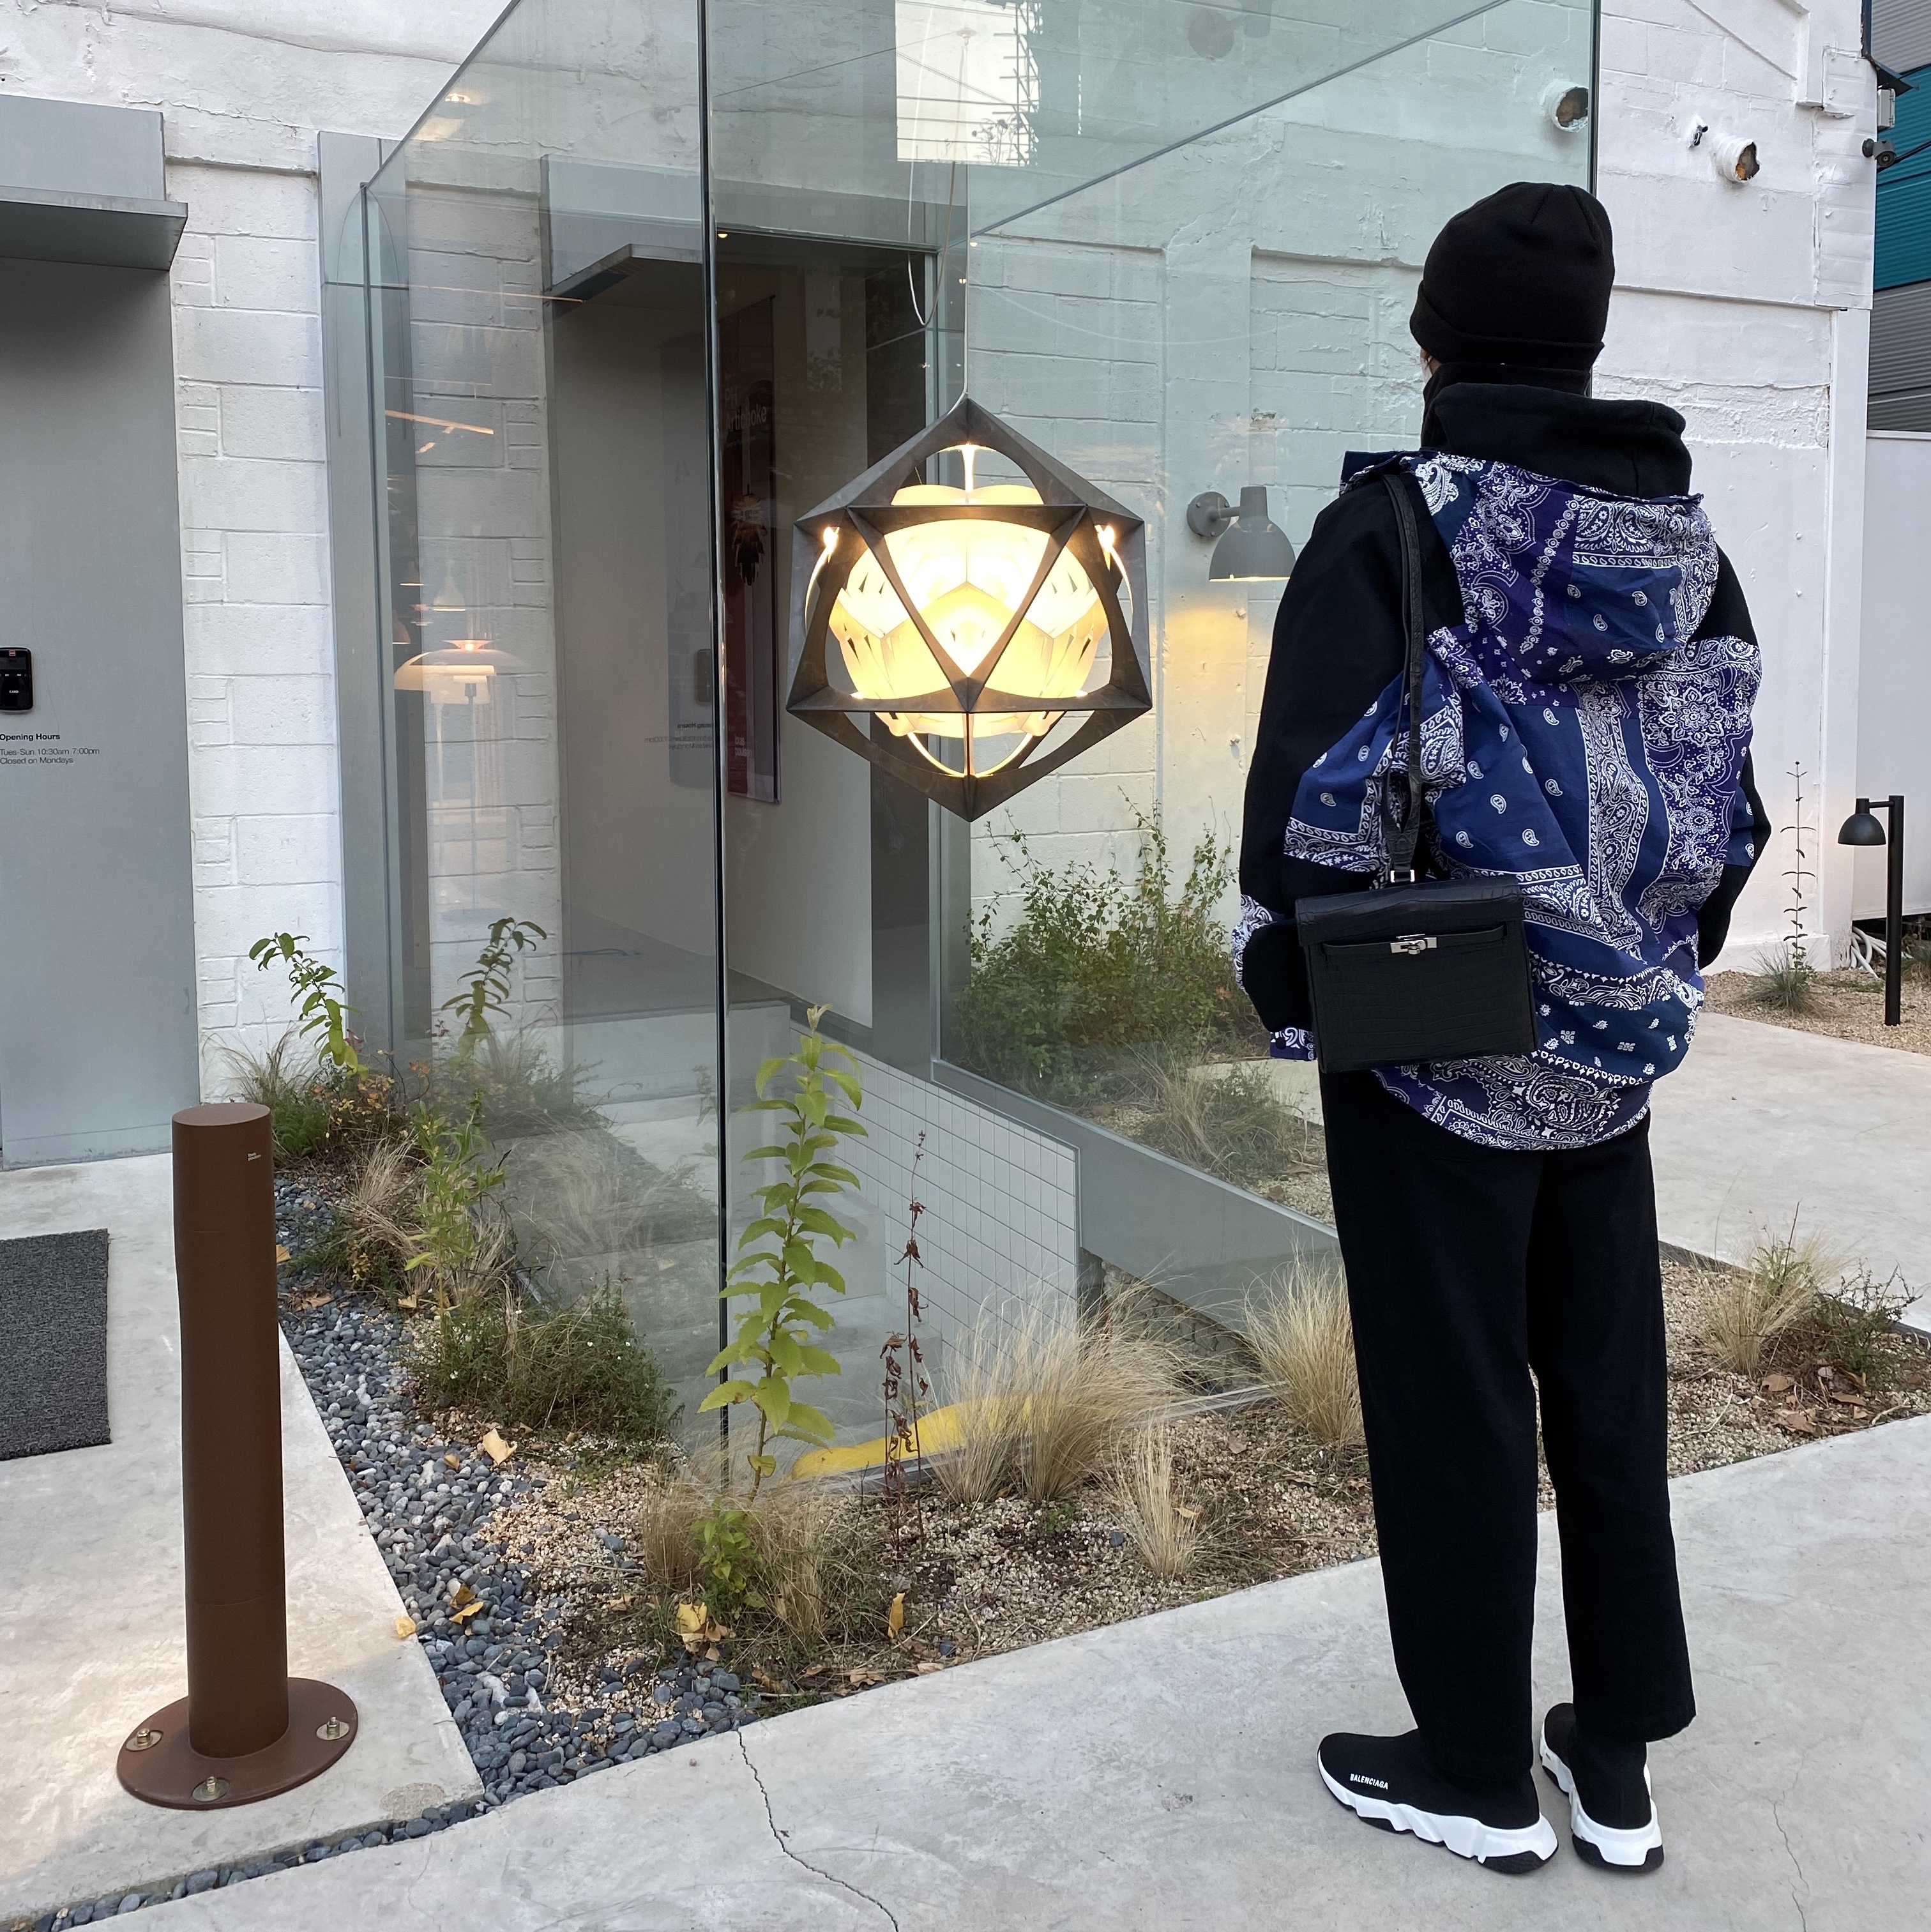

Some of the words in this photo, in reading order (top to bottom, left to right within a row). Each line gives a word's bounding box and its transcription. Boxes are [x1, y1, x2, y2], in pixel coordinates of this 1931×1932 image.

[0, 733, 34, 742] Opening
[0, 748, 35, 756] Tues-Sun
[72, 747, 100, 756] 7:00pm
[39, 756, 74, 764] Mondays
[1350, 1773, 1388, 1790] BALENCIAGA
